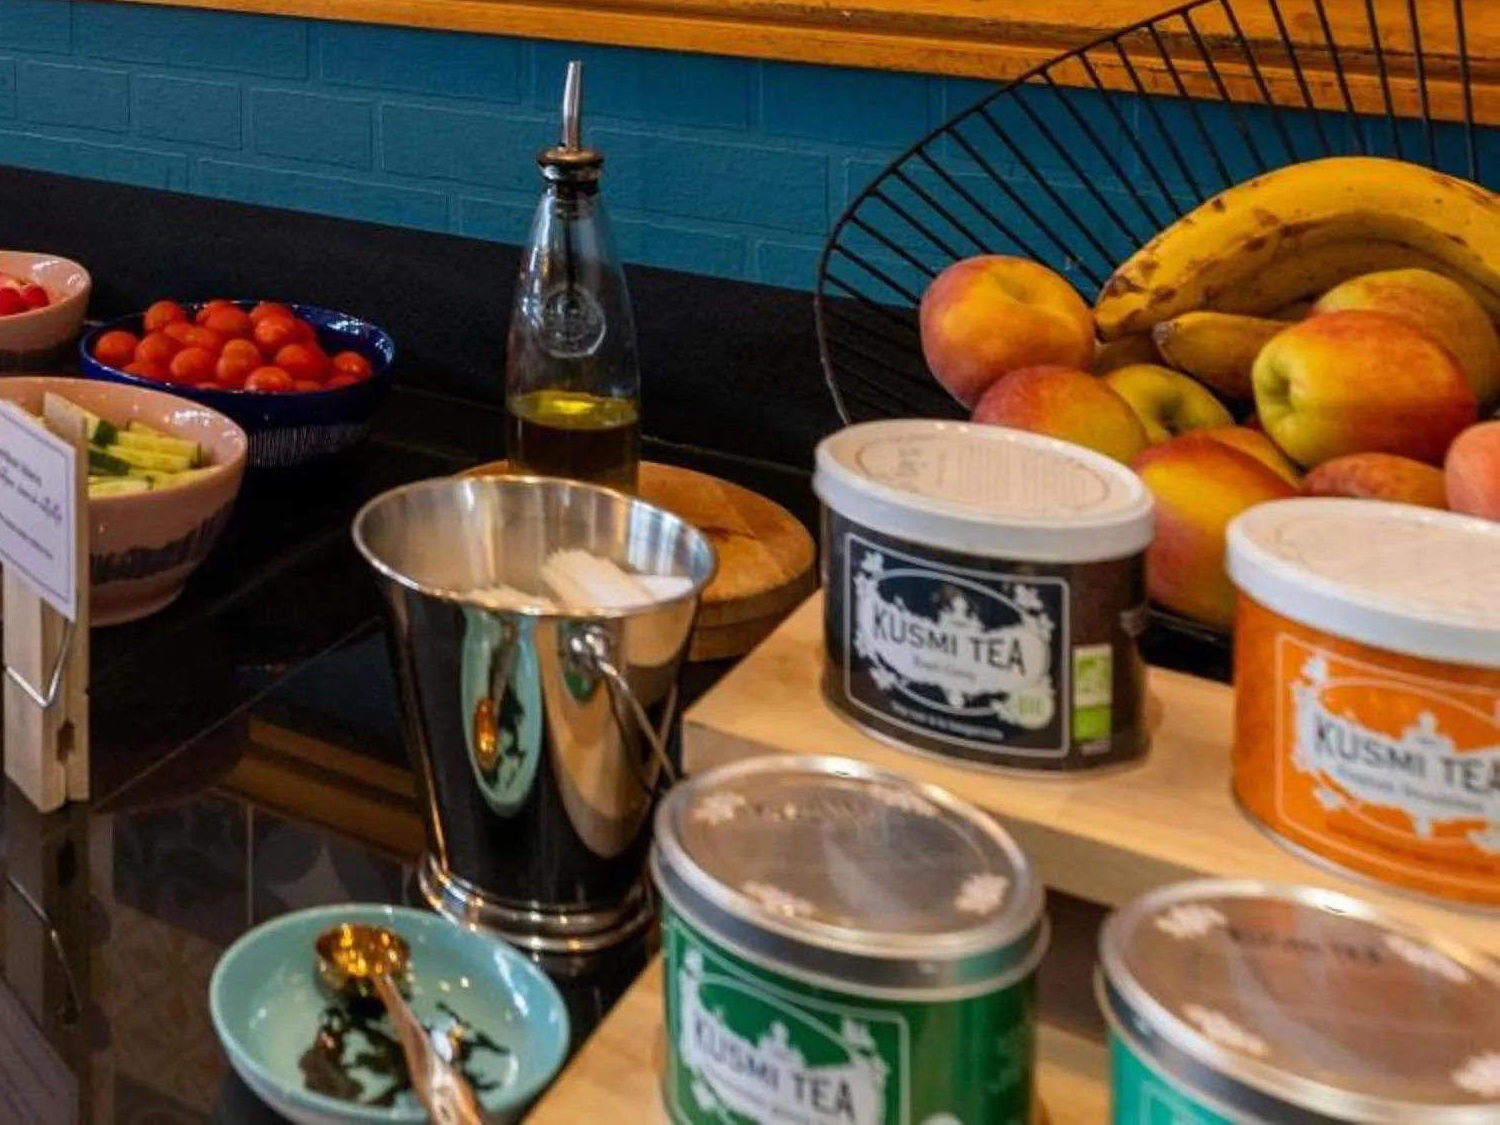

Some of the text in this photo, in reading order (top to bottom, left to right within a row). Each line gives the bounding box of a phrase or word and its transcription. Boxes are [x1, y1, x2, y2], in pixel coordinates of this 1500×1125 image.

[872, 601, 1028, 677] KUSMI TEA
[1314, 711, 1426, 781] KUSMI
[791, 1074, 857, 1122] TEA
